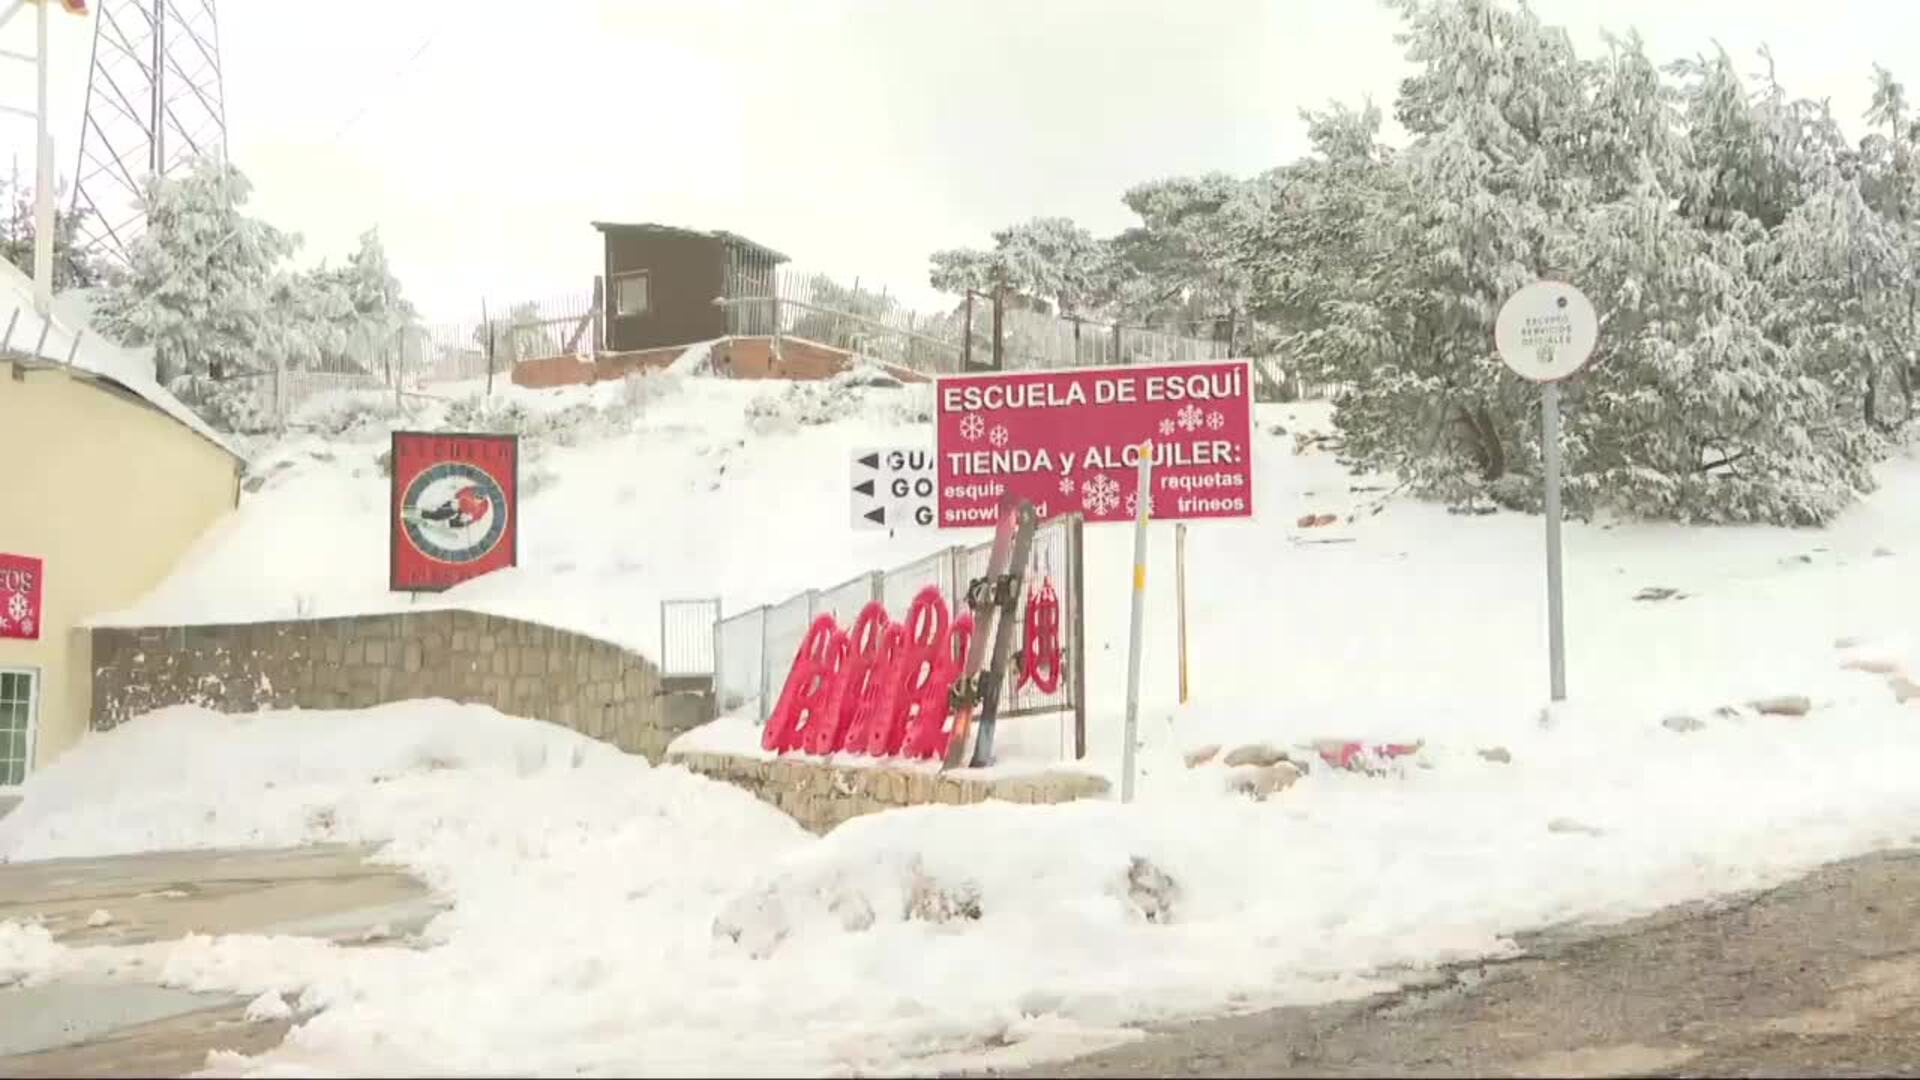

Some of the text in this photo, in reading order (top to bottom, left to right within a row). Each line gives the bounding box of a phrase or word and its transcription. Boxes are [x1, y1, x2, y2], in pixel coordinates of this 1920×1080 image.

[943, 367, 1241, 413] ESCUELA DE ESQUÍ
[886, 450, 934, 471] GU
[947, 448, 1053, 476] TIENDA
[1058, 452, 1075, 475] y
[944, 480, 1005, 502] esquis
[1160, 473, 1244, 491] raquetas
[1178, 495, 1244, 513] trineos
